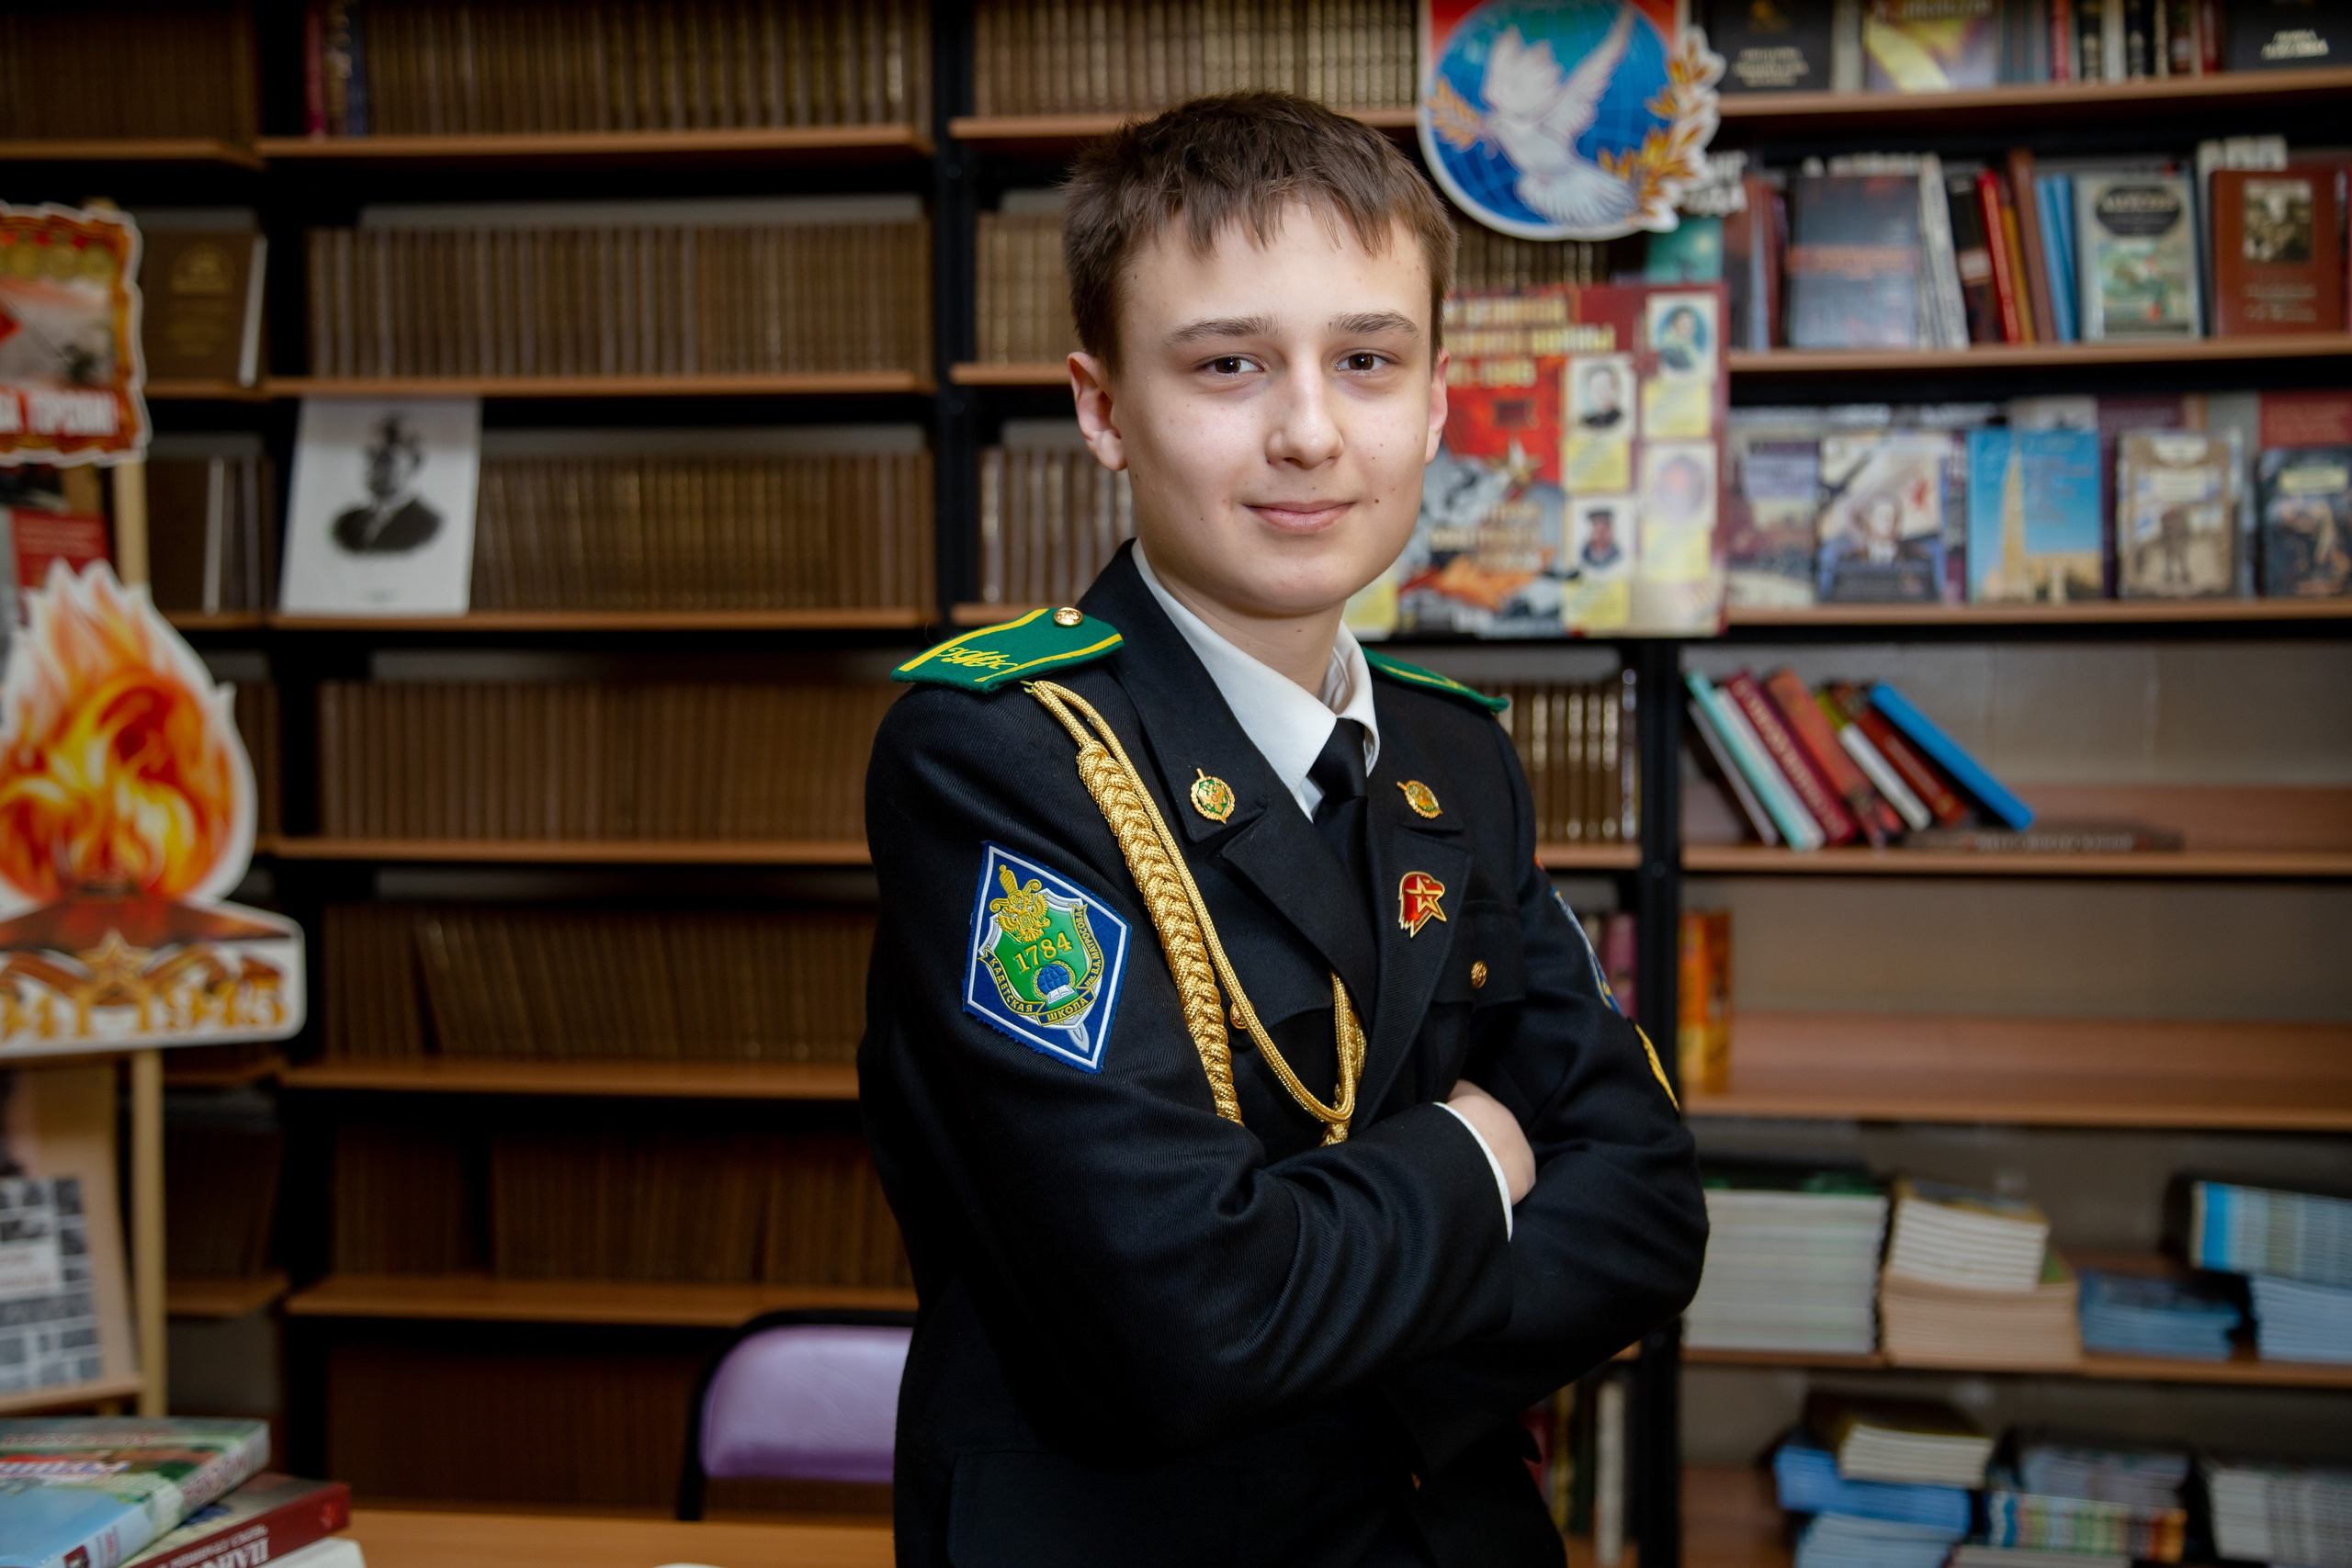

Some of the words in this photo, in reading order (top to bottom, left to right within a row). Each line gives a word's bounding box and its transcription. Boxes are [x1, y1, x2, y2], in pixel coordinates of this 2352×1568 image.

[1014, 931, 1073, 974] 1784
[989, 957, 1034, 1013] КАДЕТСКАЯ
[1046, 997, 1090, 1022] ШКОЛА
